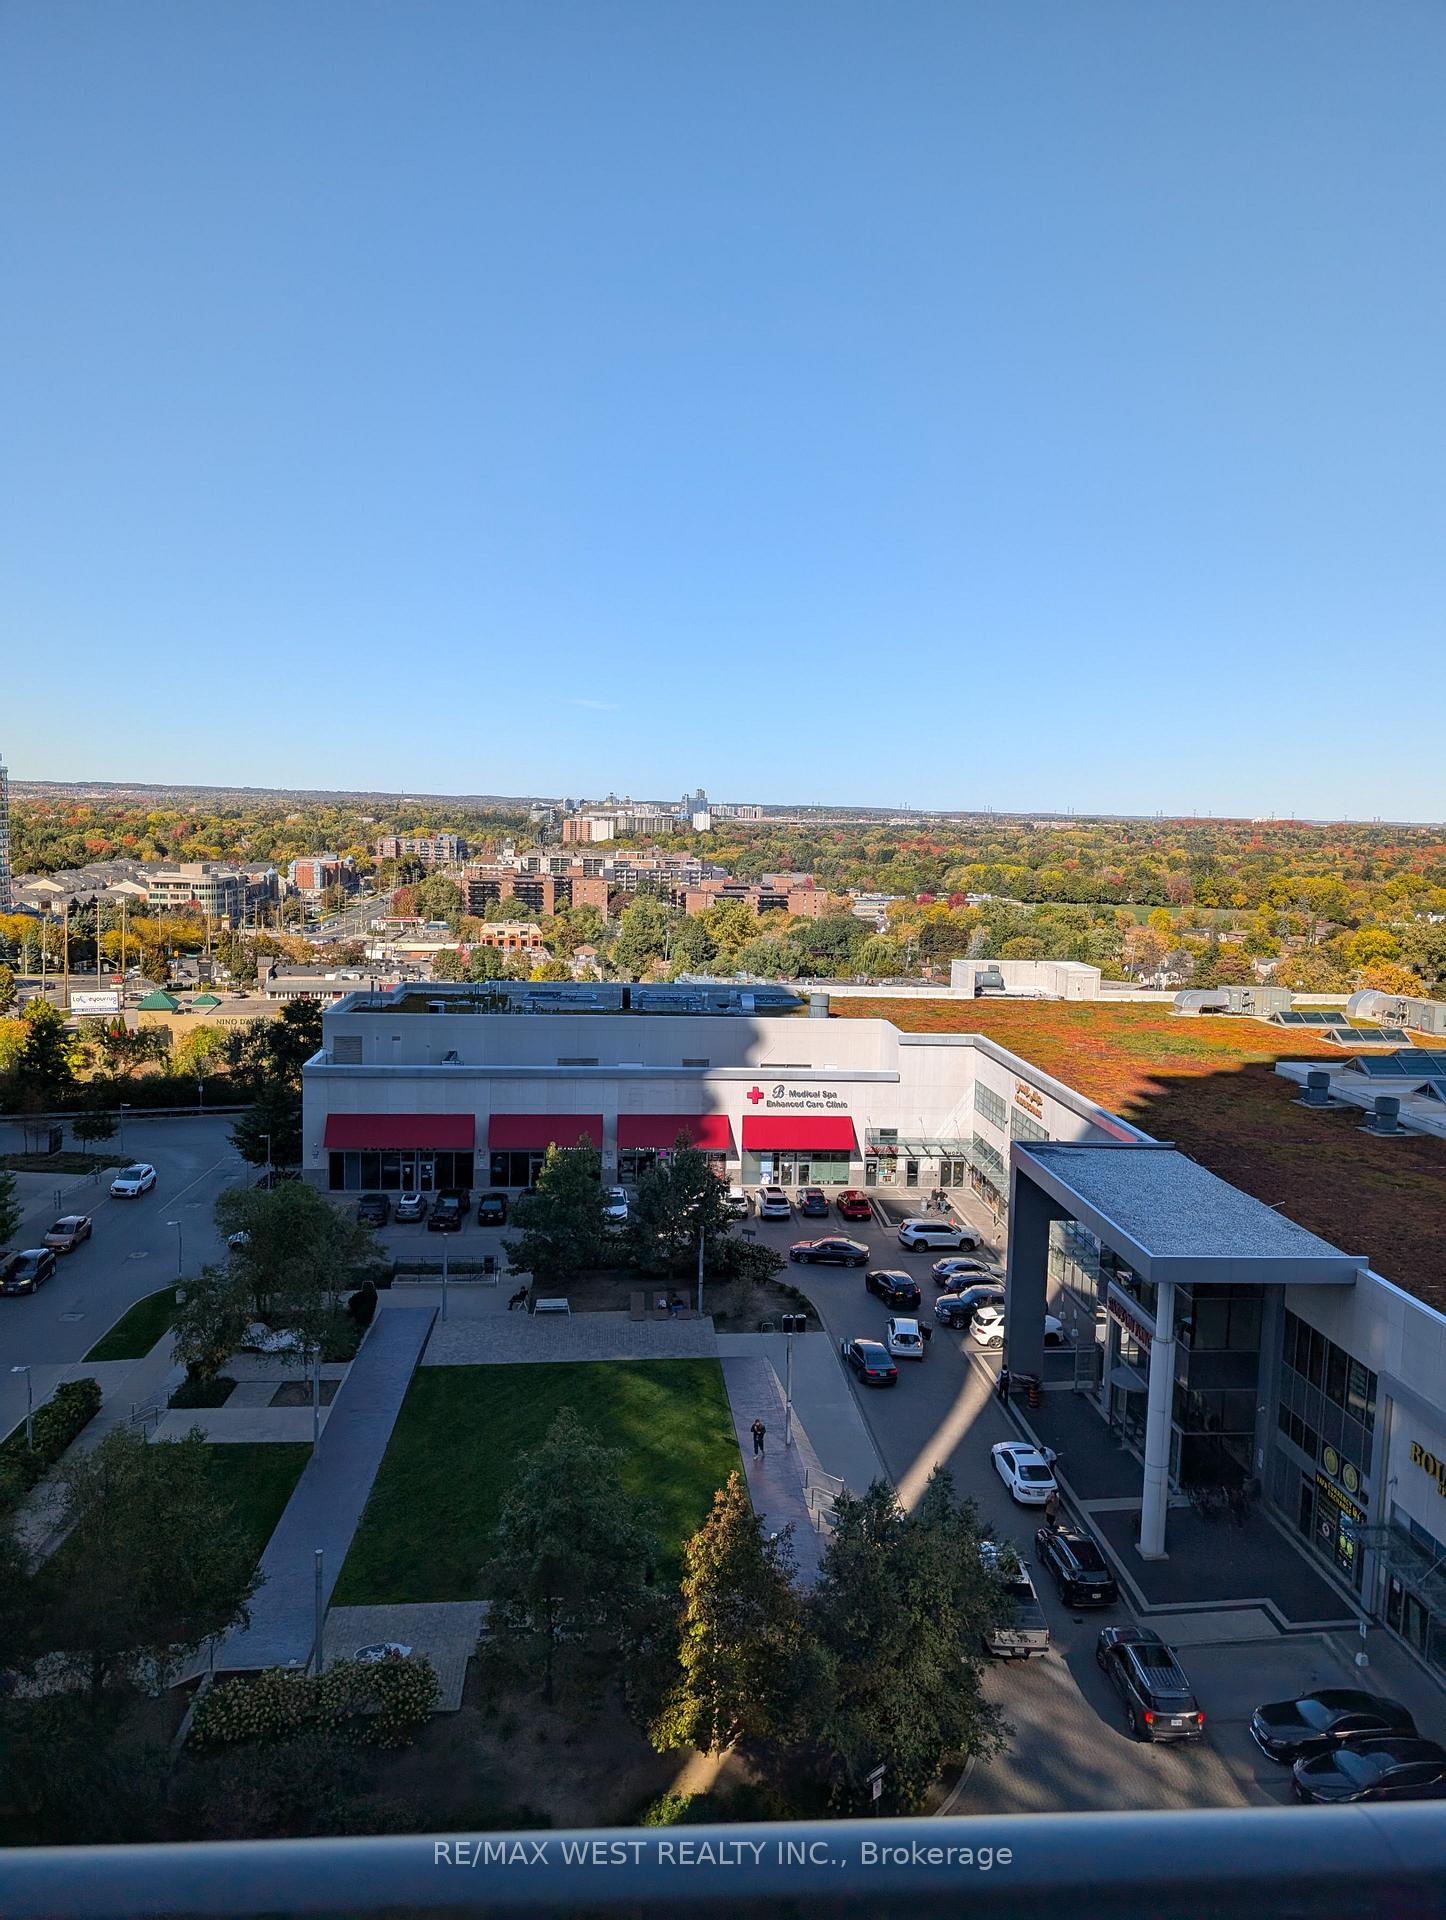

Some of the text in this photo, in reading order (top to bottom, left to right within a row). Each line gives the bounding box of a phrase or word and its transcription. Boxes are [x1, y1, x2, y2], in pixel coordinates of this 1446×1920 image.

[788, 1090, 821, 1099] Medical
[822, 1090, 838, 1100] Spa
[766, 1100, 848, 1109] Enhanced Care Clinic
